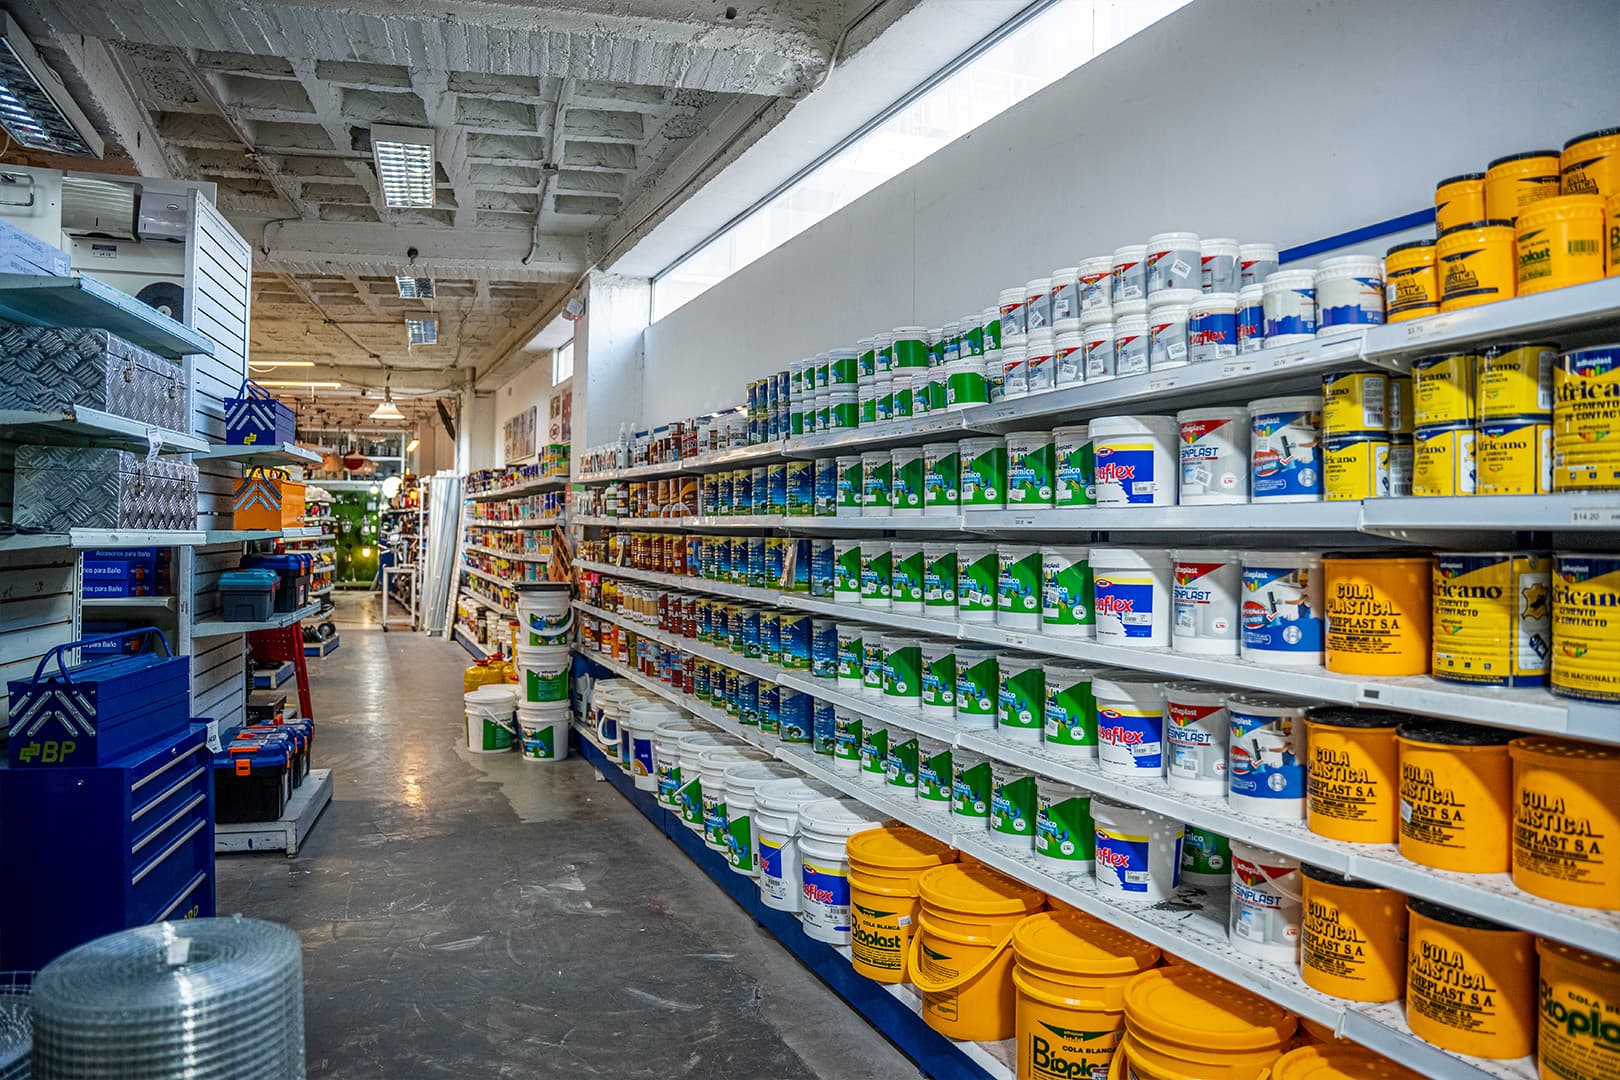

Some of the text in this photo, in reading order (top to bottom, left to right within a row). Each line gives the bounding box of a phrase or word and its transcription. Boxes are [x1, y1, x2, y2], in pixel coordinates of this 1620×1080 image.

[137, 550, 151, 558] Baño
[107, 566, 122, 574] Baño
[108, 584, 123, 593] Baño
[1336, 583, 1374, 600] COLA
[102, 640, 117, 648] Baño
[41, 741, 77, 763] BP
[1315, 746, 1350, 767] COLA
[1521, 786, 1565, 815] COLA
[1422, 940, 1465, 971] COLA
[1568, 990, 1601, 1010] COLA
[1062, 1045, 1083, 1054] COLA
